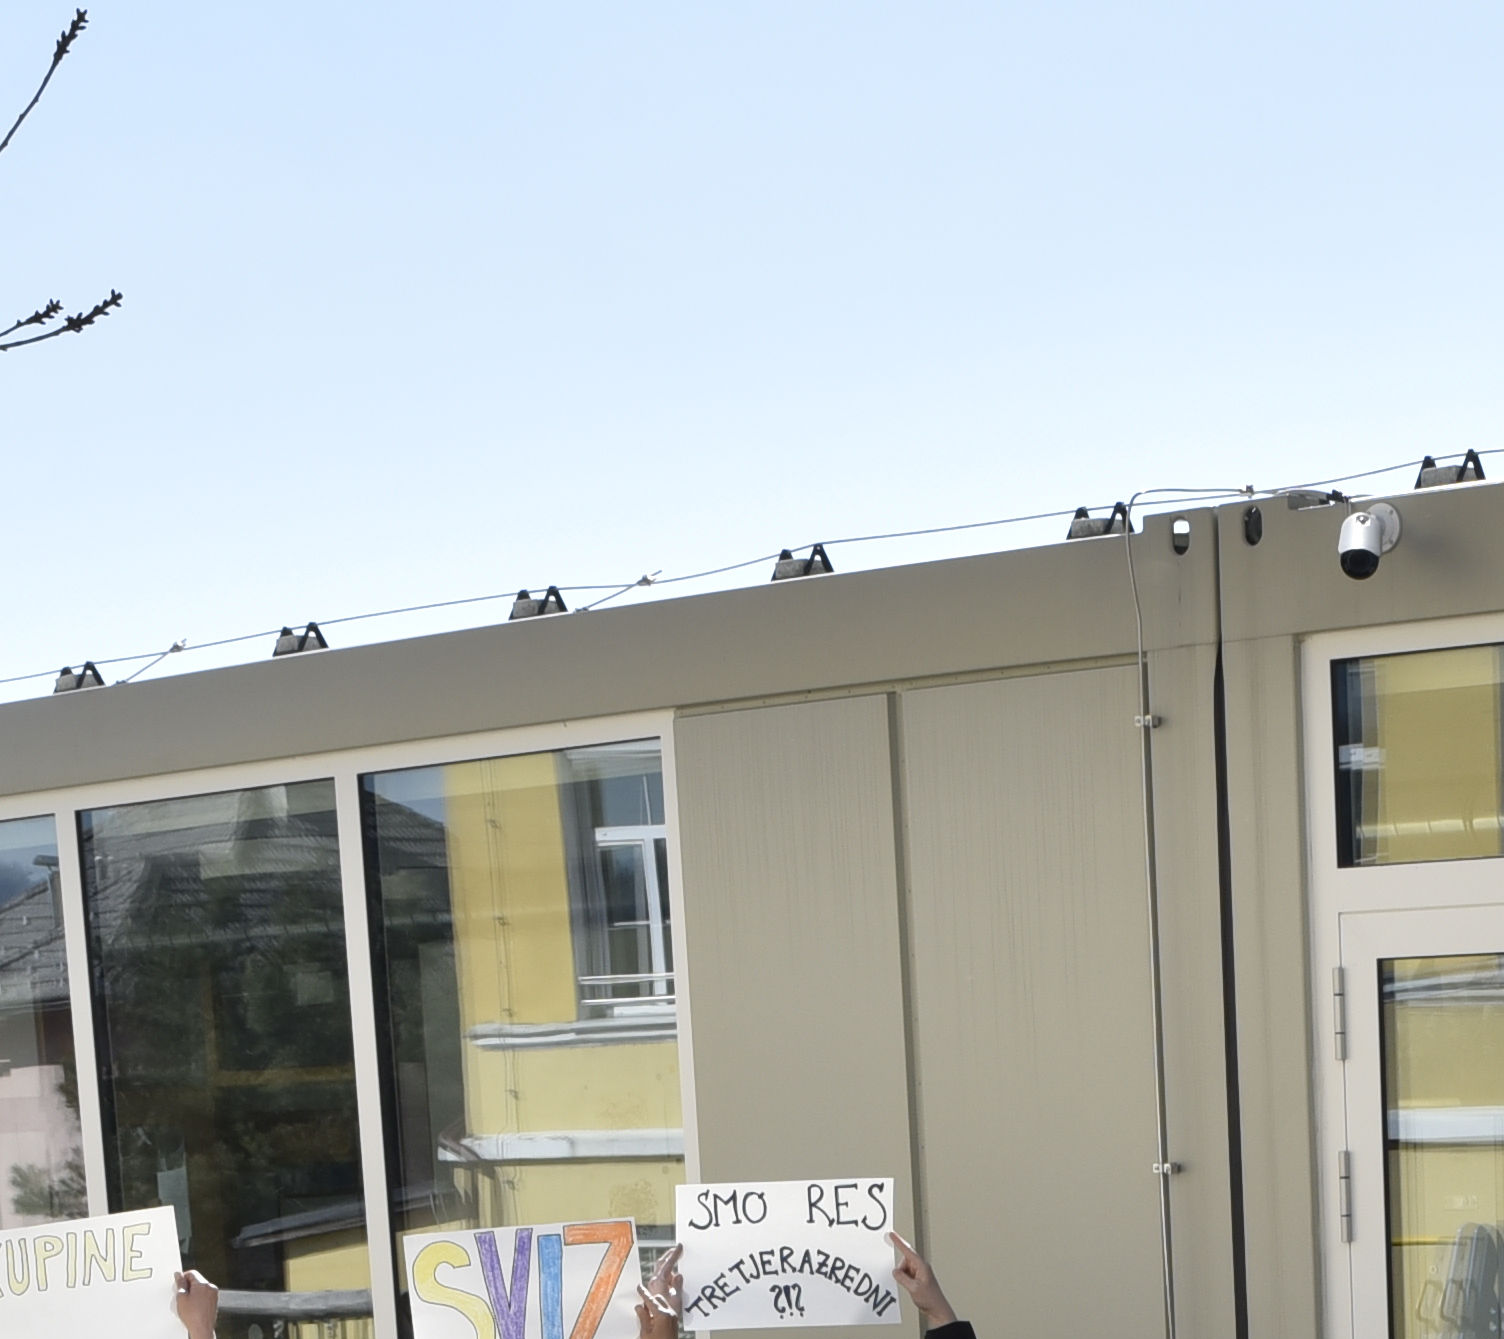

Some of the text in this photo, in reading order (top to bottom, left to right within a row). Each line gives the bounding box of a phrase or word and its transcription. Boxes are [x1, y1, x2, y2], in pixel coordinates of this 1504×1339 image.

[688, 1183, 887, 1231] SMO RES
[685, 1246, 896, 1317] TRETJERAZREDNI
